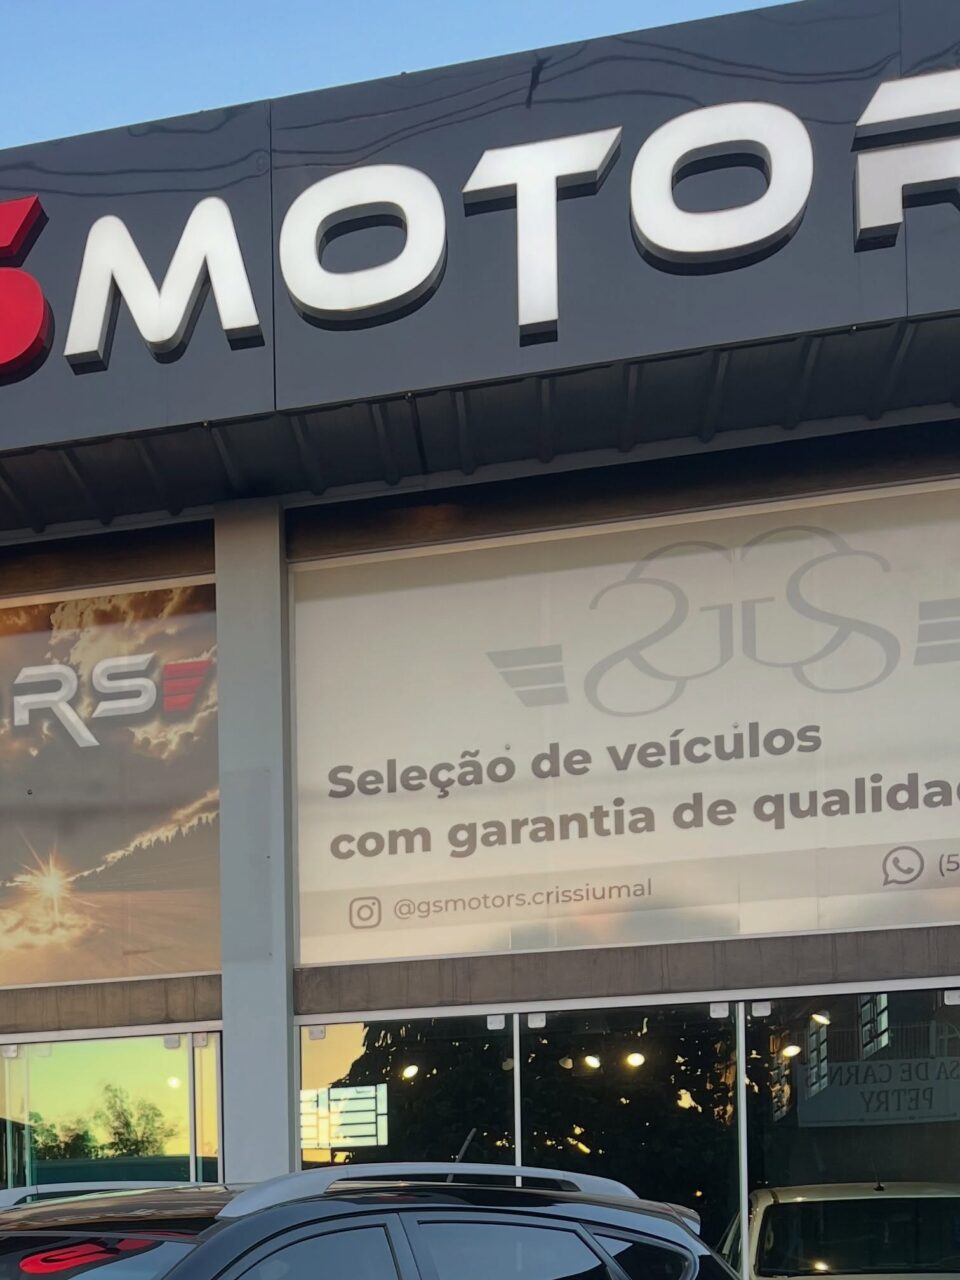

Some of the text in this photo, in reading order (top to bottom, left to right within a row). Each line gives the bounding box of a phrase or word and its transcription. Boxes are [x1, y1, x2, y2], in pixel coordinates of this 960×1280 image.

[327, 720, 823, 799] Seleção de veículos
[329, 772, 960, 860] com garantia de qualida
[393, 878, 653, 921] @gsmotors.crissiumal
